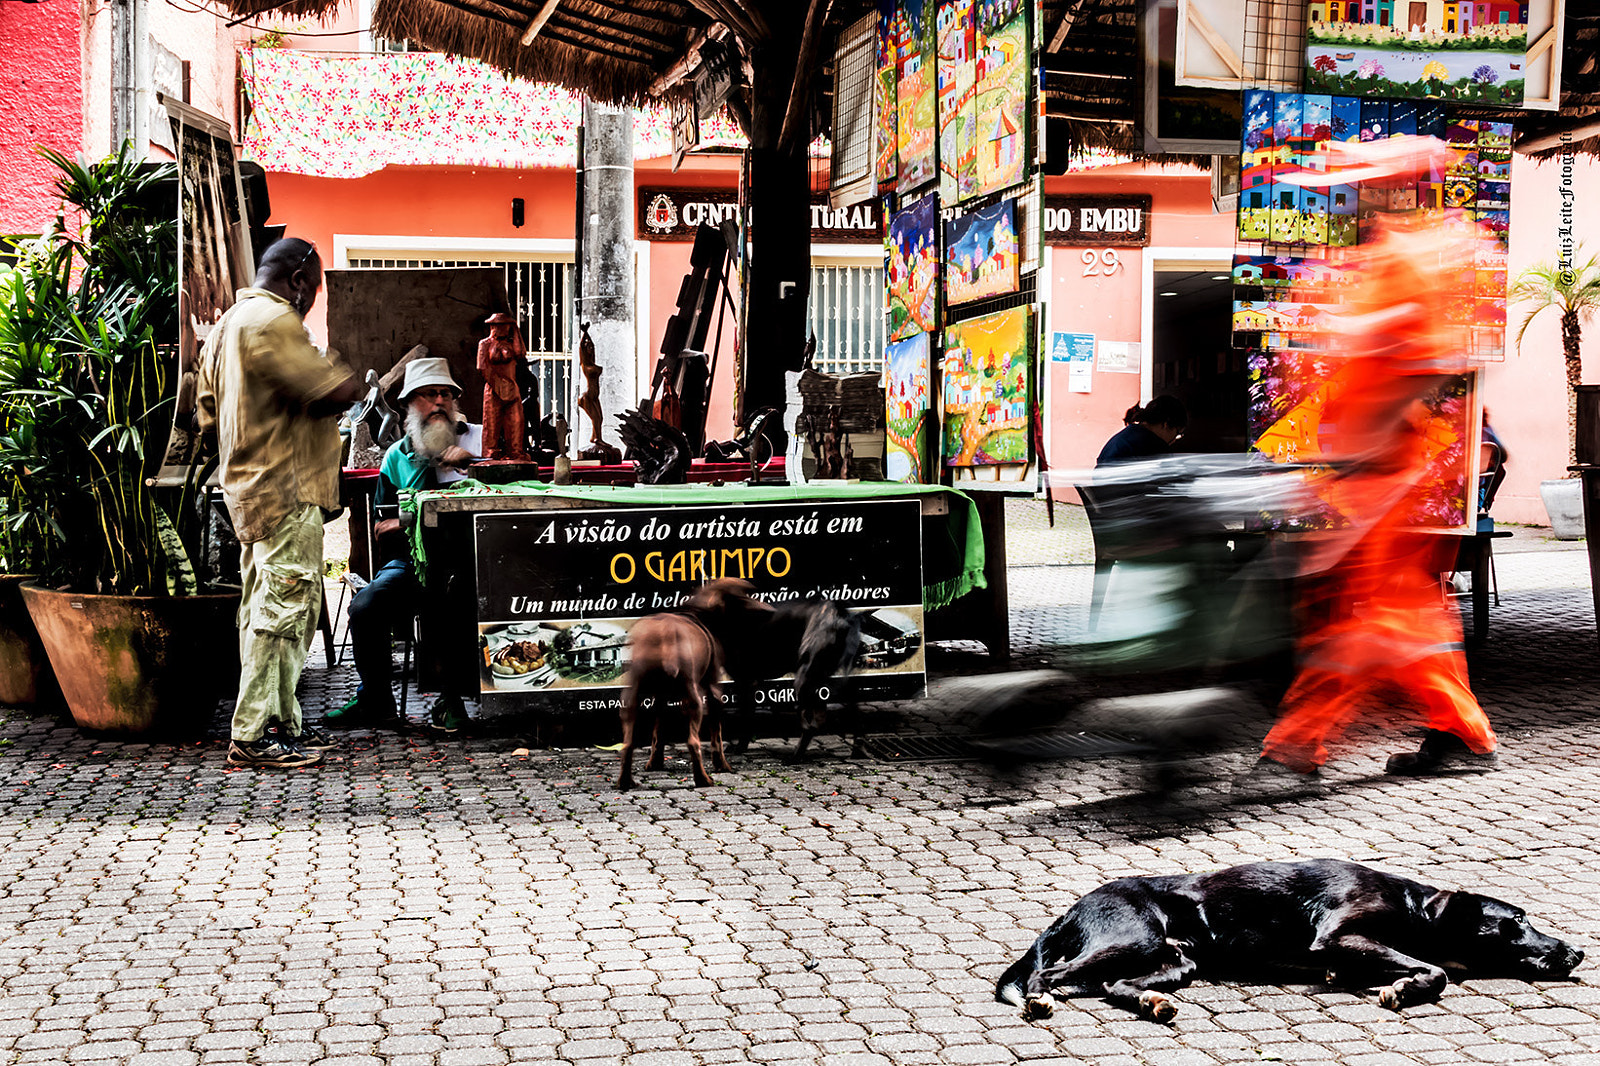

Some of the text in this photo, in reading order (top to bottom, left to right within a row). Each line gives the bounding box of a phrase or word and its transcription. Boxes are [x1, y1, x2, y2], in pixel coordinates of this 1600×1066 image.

[683, 203, 1141, 233] CENT TURAL DO EMBU
[1081, 247, 1121, 278] 29
[534, 511, 863, 545] A visão do artista está em
[610, 546, 792, 584] O GARIMPO
[510, 596, 544, 614] Um
[550, 593, 618, 616] mundo
[623, 592, 646, 610] de
[651, 590, 695, 609] bele
[746, 586, 800, 604] ersão
[821, 587, 891, 601] sabores
[579, 700, 607, 710] ESTA
